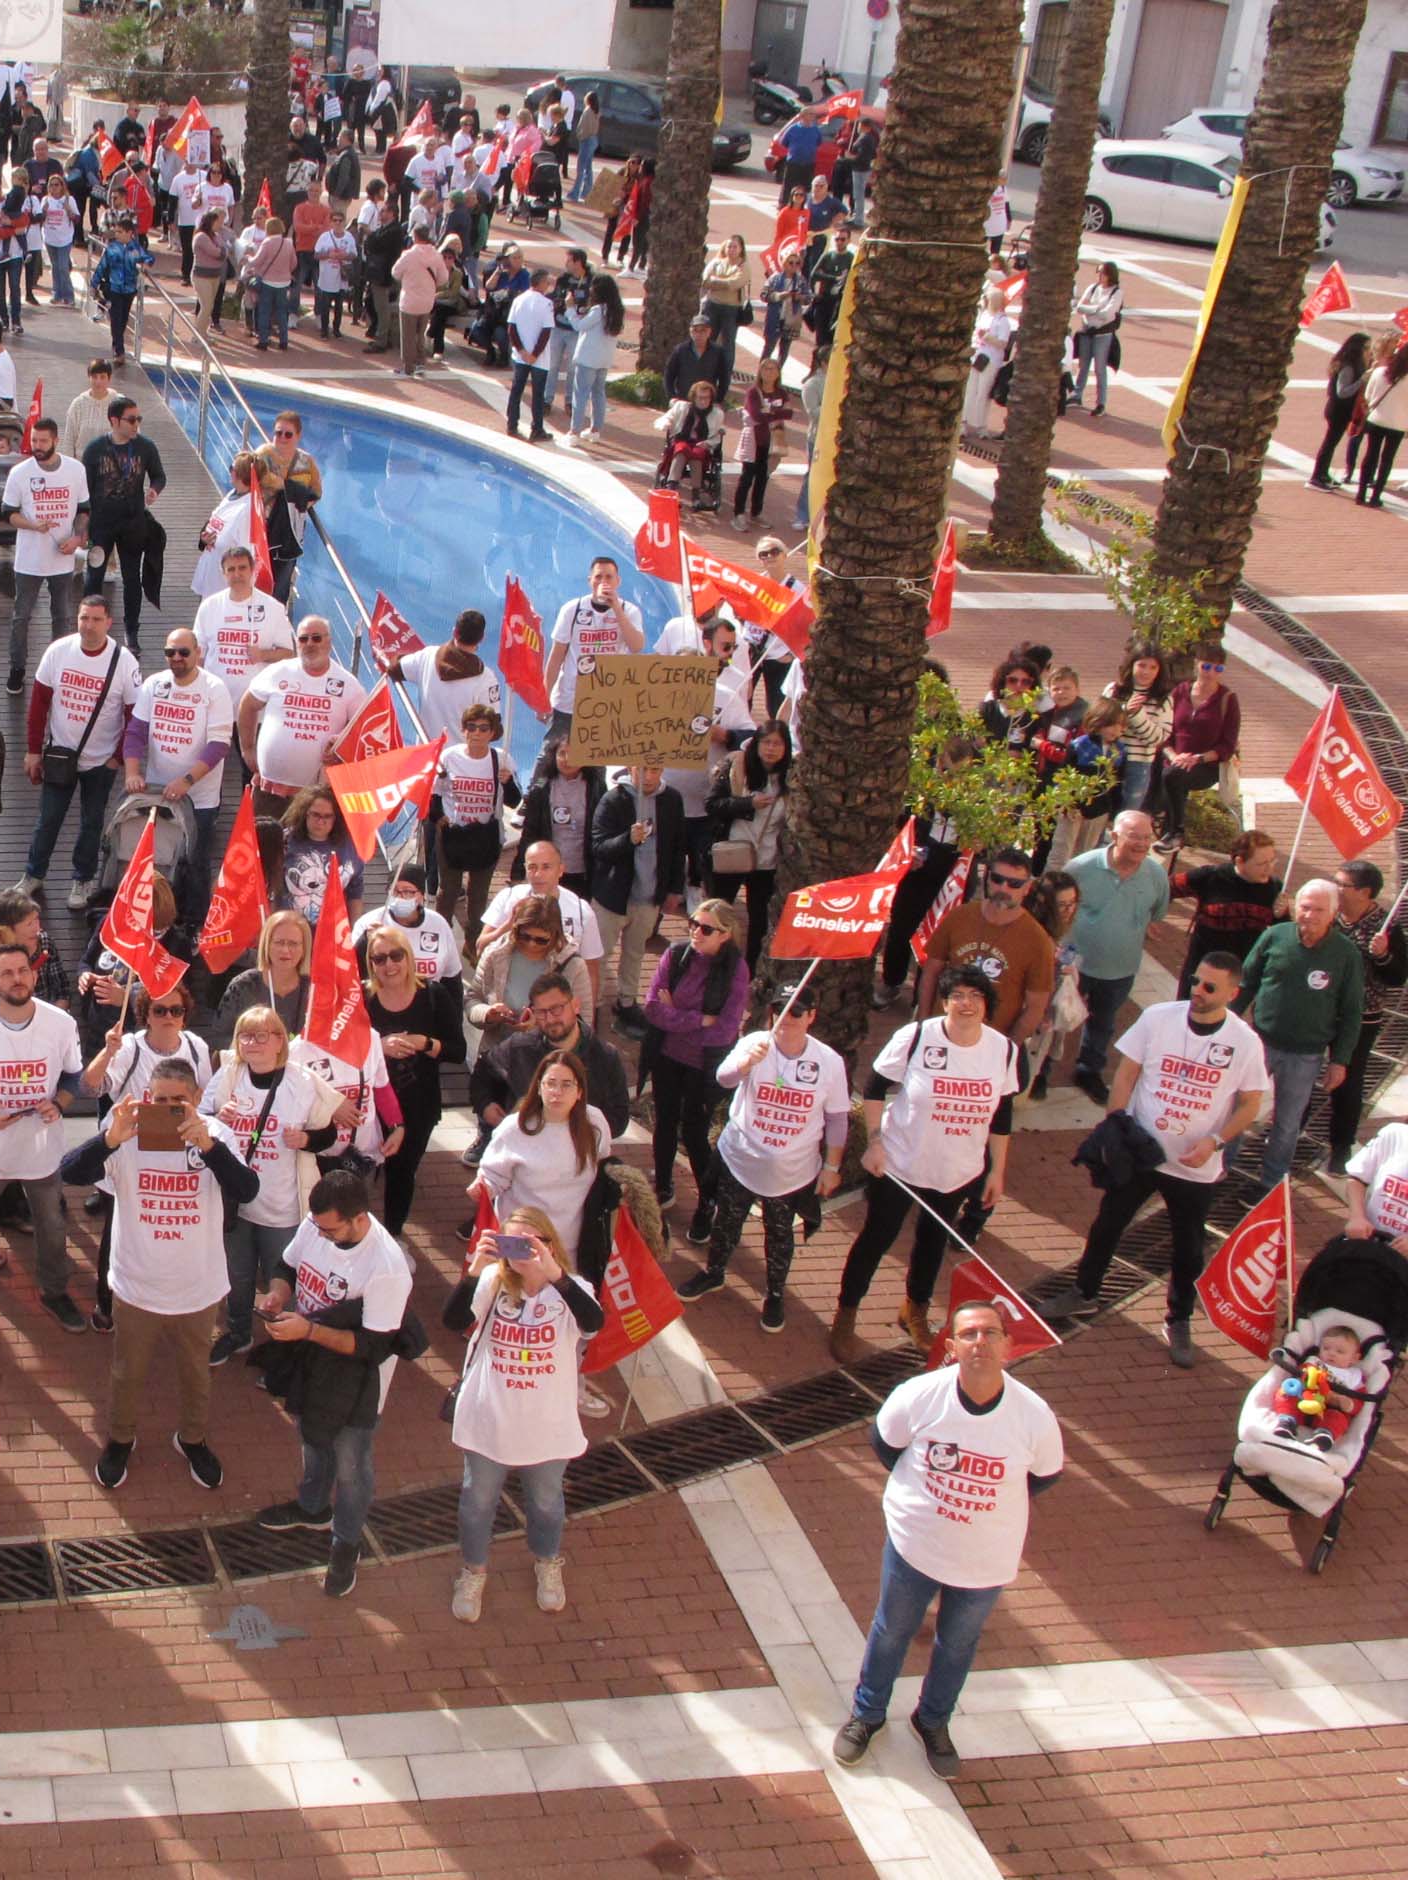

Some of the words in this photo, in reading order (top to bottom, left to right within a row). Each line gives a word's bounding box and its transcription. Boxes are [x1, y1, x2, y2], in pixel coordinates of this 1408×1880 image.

[33, 489, 70, 502] BIMBO
[47, 503, 69, 511] LLEVA
[579, 630, 618, 642] BIMBO
[59, 671, 105, 692] BIMBO
[591, 666, 617, 689] NO
[623, 668, 640, 685] AL
[648, 662, 718, 687] CIERRE
[62, 690, 71, 698] SE
[284, 694, 332, 710] BIMBO
[577, 697, 622, 719] CON
[636, 689, 657, 713] EL
[154, 704, 195, 721] BIMBO
[299, 711, 329, 722] LLEVA
[155, 722, 165, 730] SE
[167, 724, 192, 735] LLEVA
[283, 721, 330, 732] NUESTRO
[578, 725, 600, 744] DE
[611, 717, 685, 744] NUESTRA
[153, 732, 192, 745] NUESTRO
[587, 740, 658, 760] FAMILIA
[679, 734, 703, 747] NO
[644, 753, 666, 765] SE
[670, 749, 709, 761] JUEGA
[452, 779, 494, 792] BIMBO
[465, 796, 491, 804] LLEVA
[1332, 787, 1373, 837] Valencià
[1161, 1057, 1222, 1085] BIMBO
[8, 1085, 46, 1095] LLEVA
[933, 1079, 992, 1097] BIMBO
[1159, 1078, 1174, 1090] SE
[1175, 1082, 1213, 1100] LLEVA
[757, 1084, 814, 1108] BIMBO
[1154, 1091, 1210, 1112] NUESTRO
[757, 1107, 771, 1118] SE
[773, 1109, 807, 1124] LLEVA
[936, 1102, 951, 1112] SE
[953, 1102, 991, 1114] LLEVA
[1164, 1107, 1191, 1122] PAN.
[944, 1127, 971, 1137] PAN.
[138, 1174, 200, 1192] BIMBO
[141, 1199, 157, 1210] SE
[160, 1199, 199, 1210] LLEVA
[139, 1214, 200, 1225] NUESTRO
[154, 1230, 184, 1240] PAN.
[491, 1319, 556, 1344] BIMBO
[493, 1347, 506, 1359] SE
[492, 1362, 556, 1375] NUESTRO
[507, 1379, 538, 1389] PAN.
[948, 1478, 997, 1497] LLEVA
[925, 1481, 996, 1512] NUESTRO
[936, 1506, 972, 1525] PAN.
